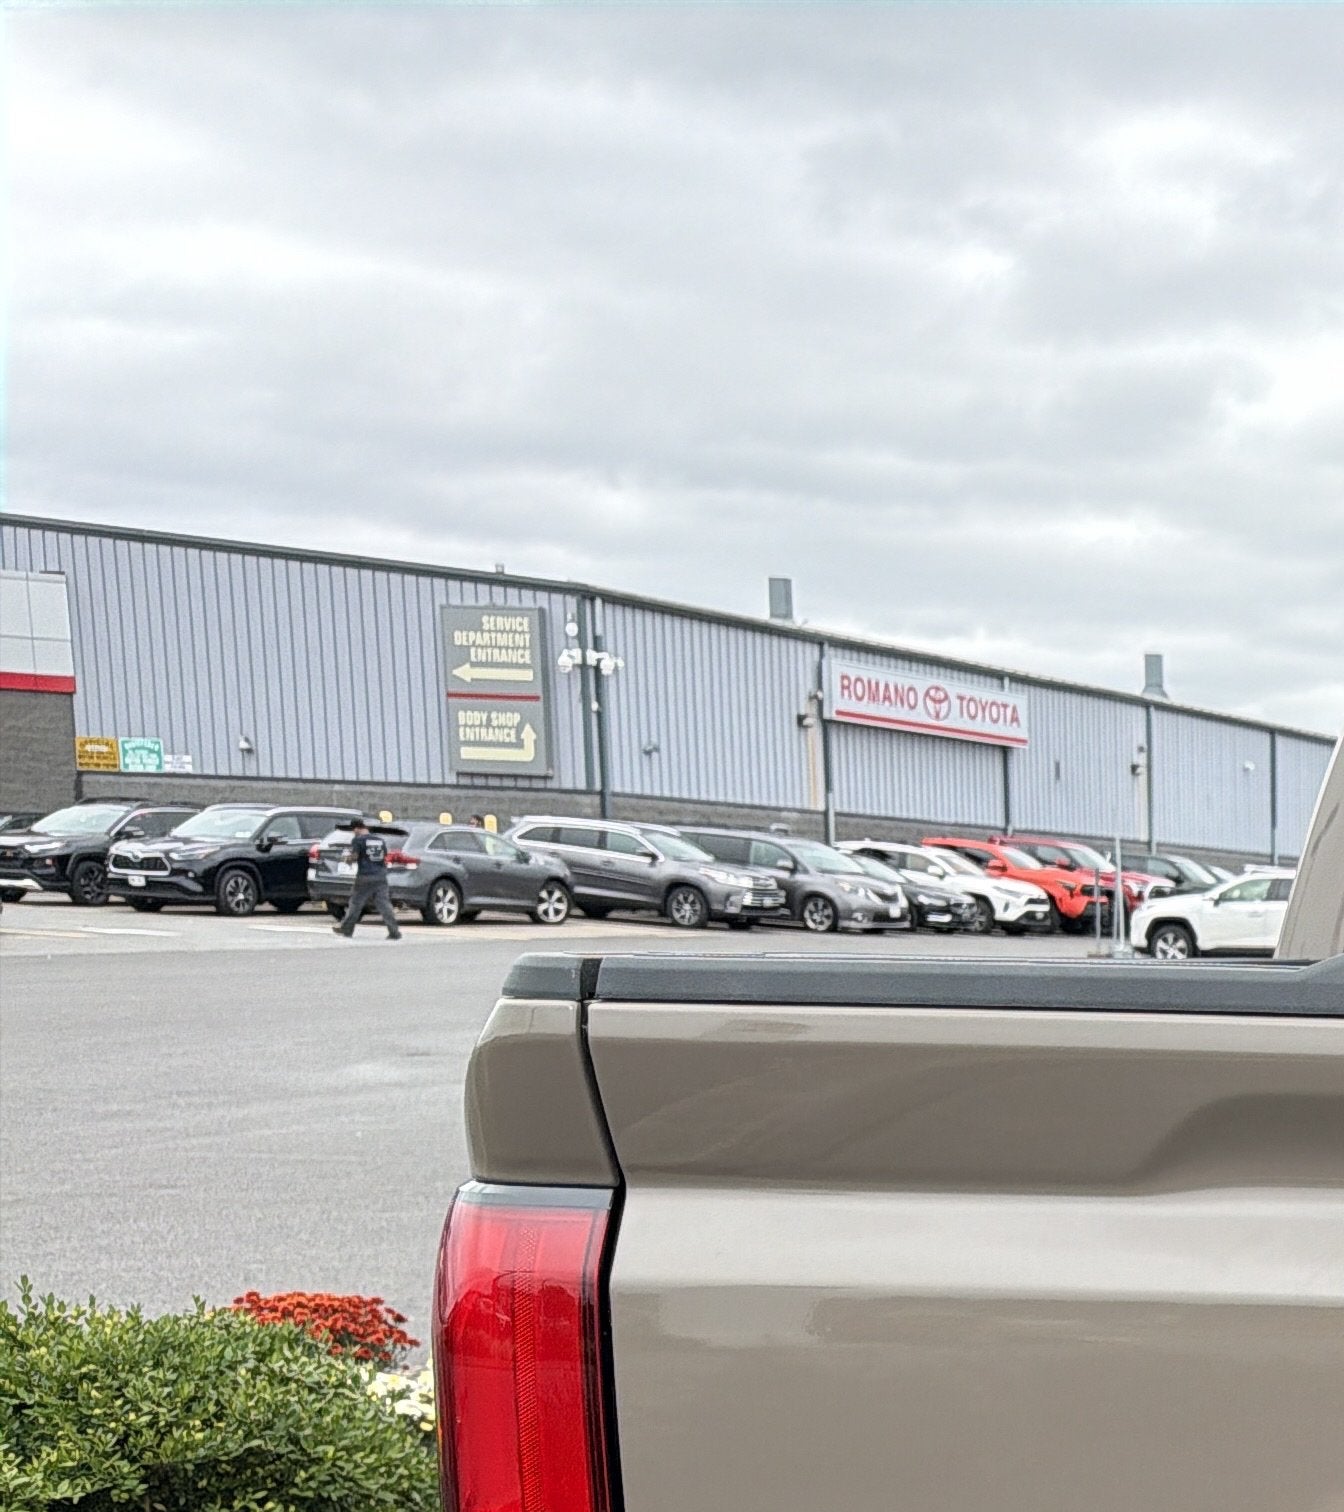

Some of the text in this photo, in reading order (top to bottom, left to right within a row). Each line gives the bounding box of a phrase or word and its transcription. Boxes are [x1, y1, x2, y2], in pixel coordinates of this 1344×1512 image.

[482, 615, 530, 631] SERVICE
[454, 630, 531, 648] DEPARTMENT
[470, 647, 532, 664] ENTRANCE
[840, 674, 1021, 728] ROMANO TOYOTA
[458, 710, 521, 727] BODY SHOP
[458, 726, 517, 743] ENTRANCE
